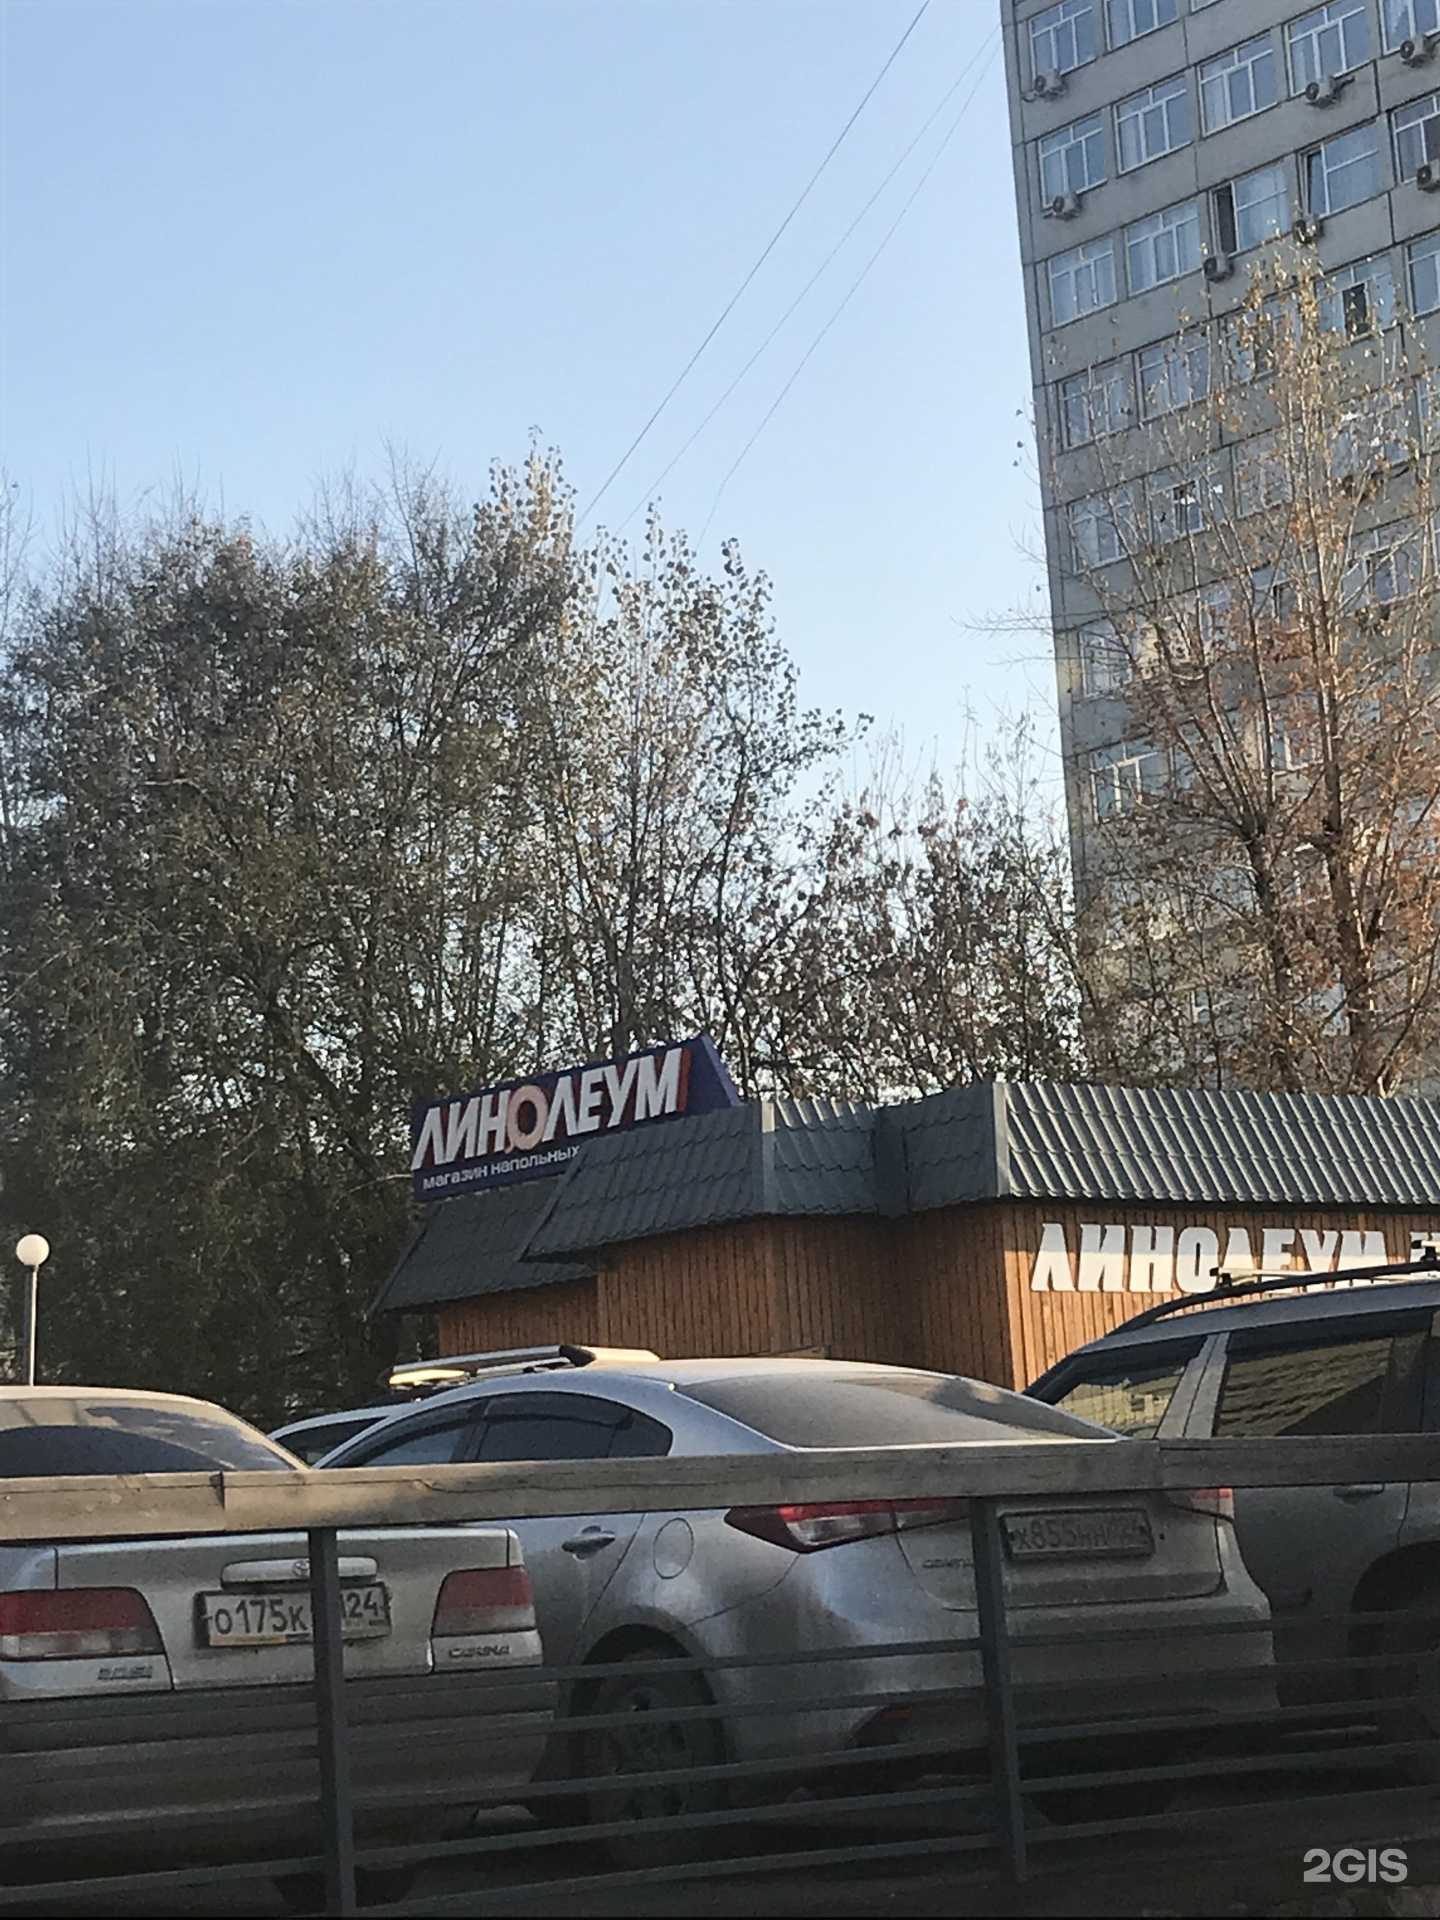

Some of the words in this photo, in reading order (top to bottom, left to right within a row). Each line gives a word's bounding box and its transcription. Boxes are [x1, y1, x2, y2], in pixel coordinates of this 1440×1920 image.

[411, 1047, 683, 1170] ЛИНОЛЕУМ
[422, 1165, 488, 1190] магазин
[490, 1145, 581, 1175] напольных
[1030, 1222, 1390, 1294] ЛИНОЛЕУМ
[214, 1598, 310, 1635] О175К
